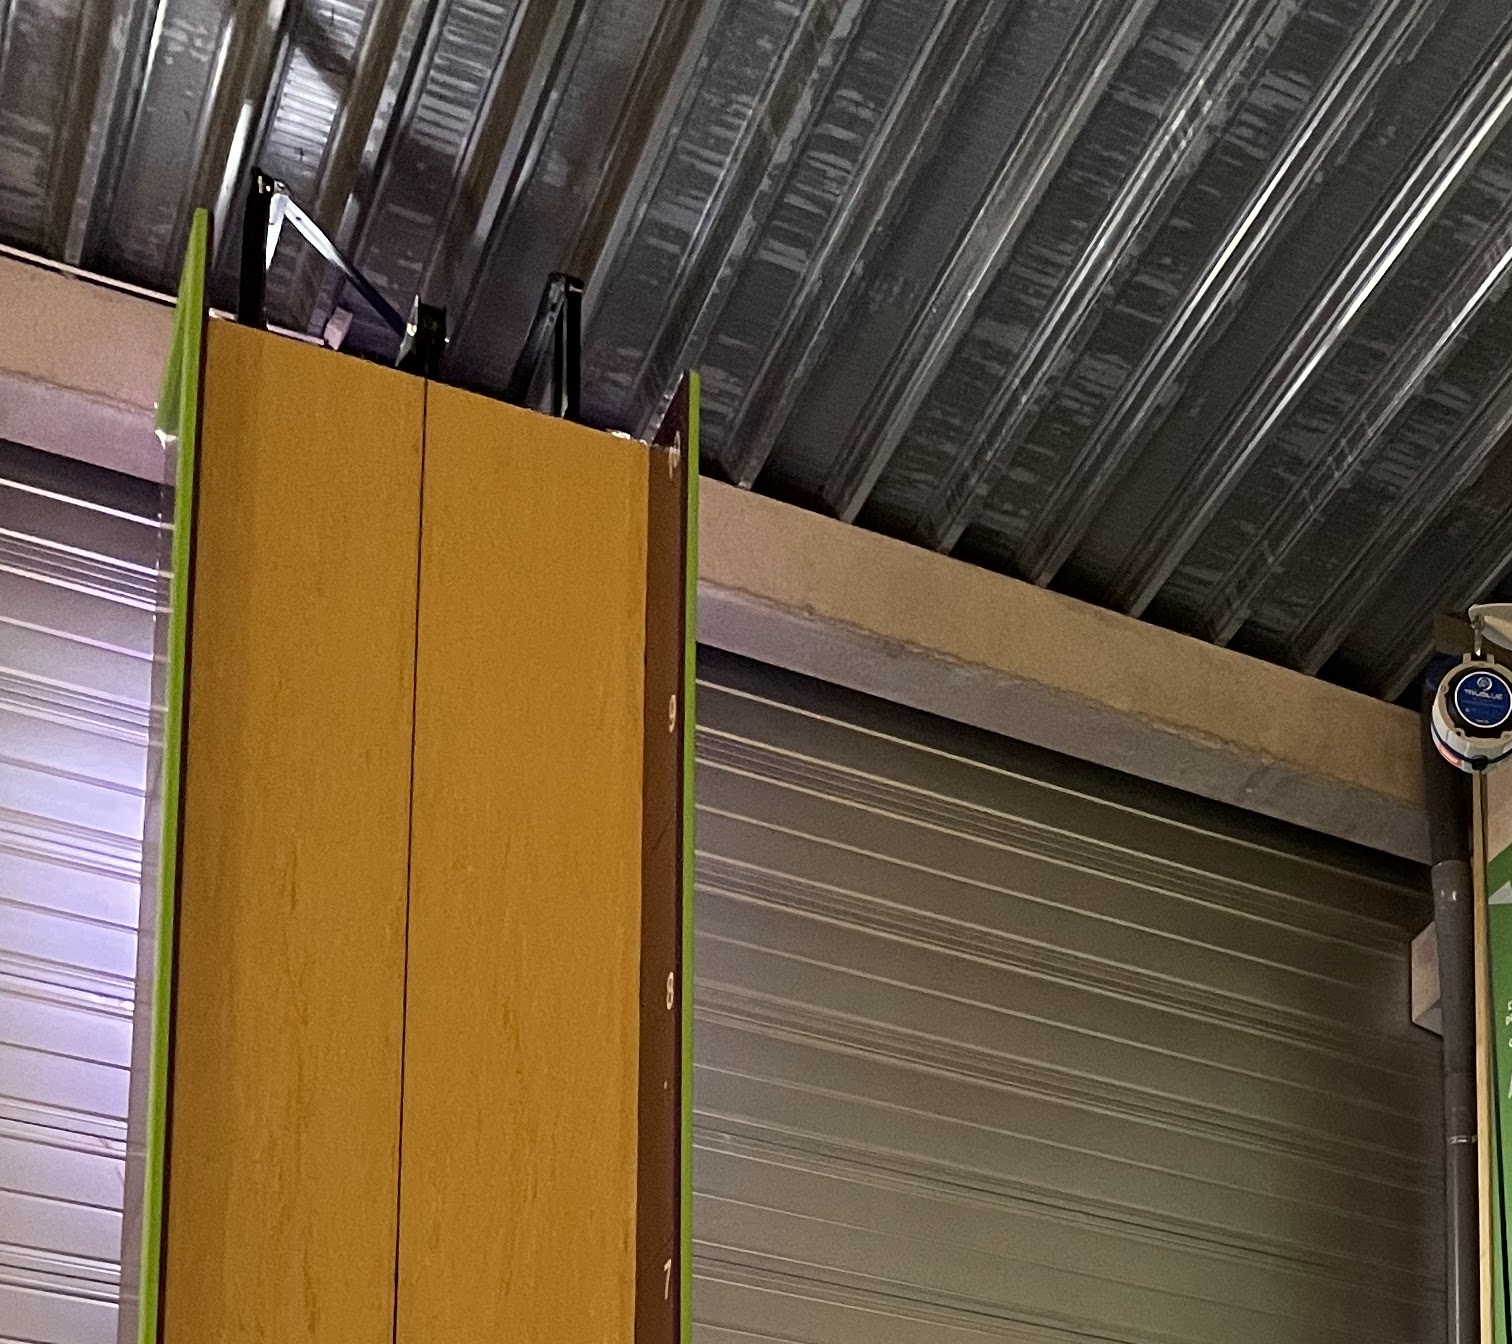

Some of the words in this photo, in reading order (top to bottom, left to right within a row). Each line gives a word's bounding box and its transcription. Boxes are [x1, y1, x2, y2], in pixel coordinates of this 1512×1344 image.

[668, 694, 677, 733] 9
[666, 971, 674, 1011] 8
[663, 1258, 672, 1300] 7
